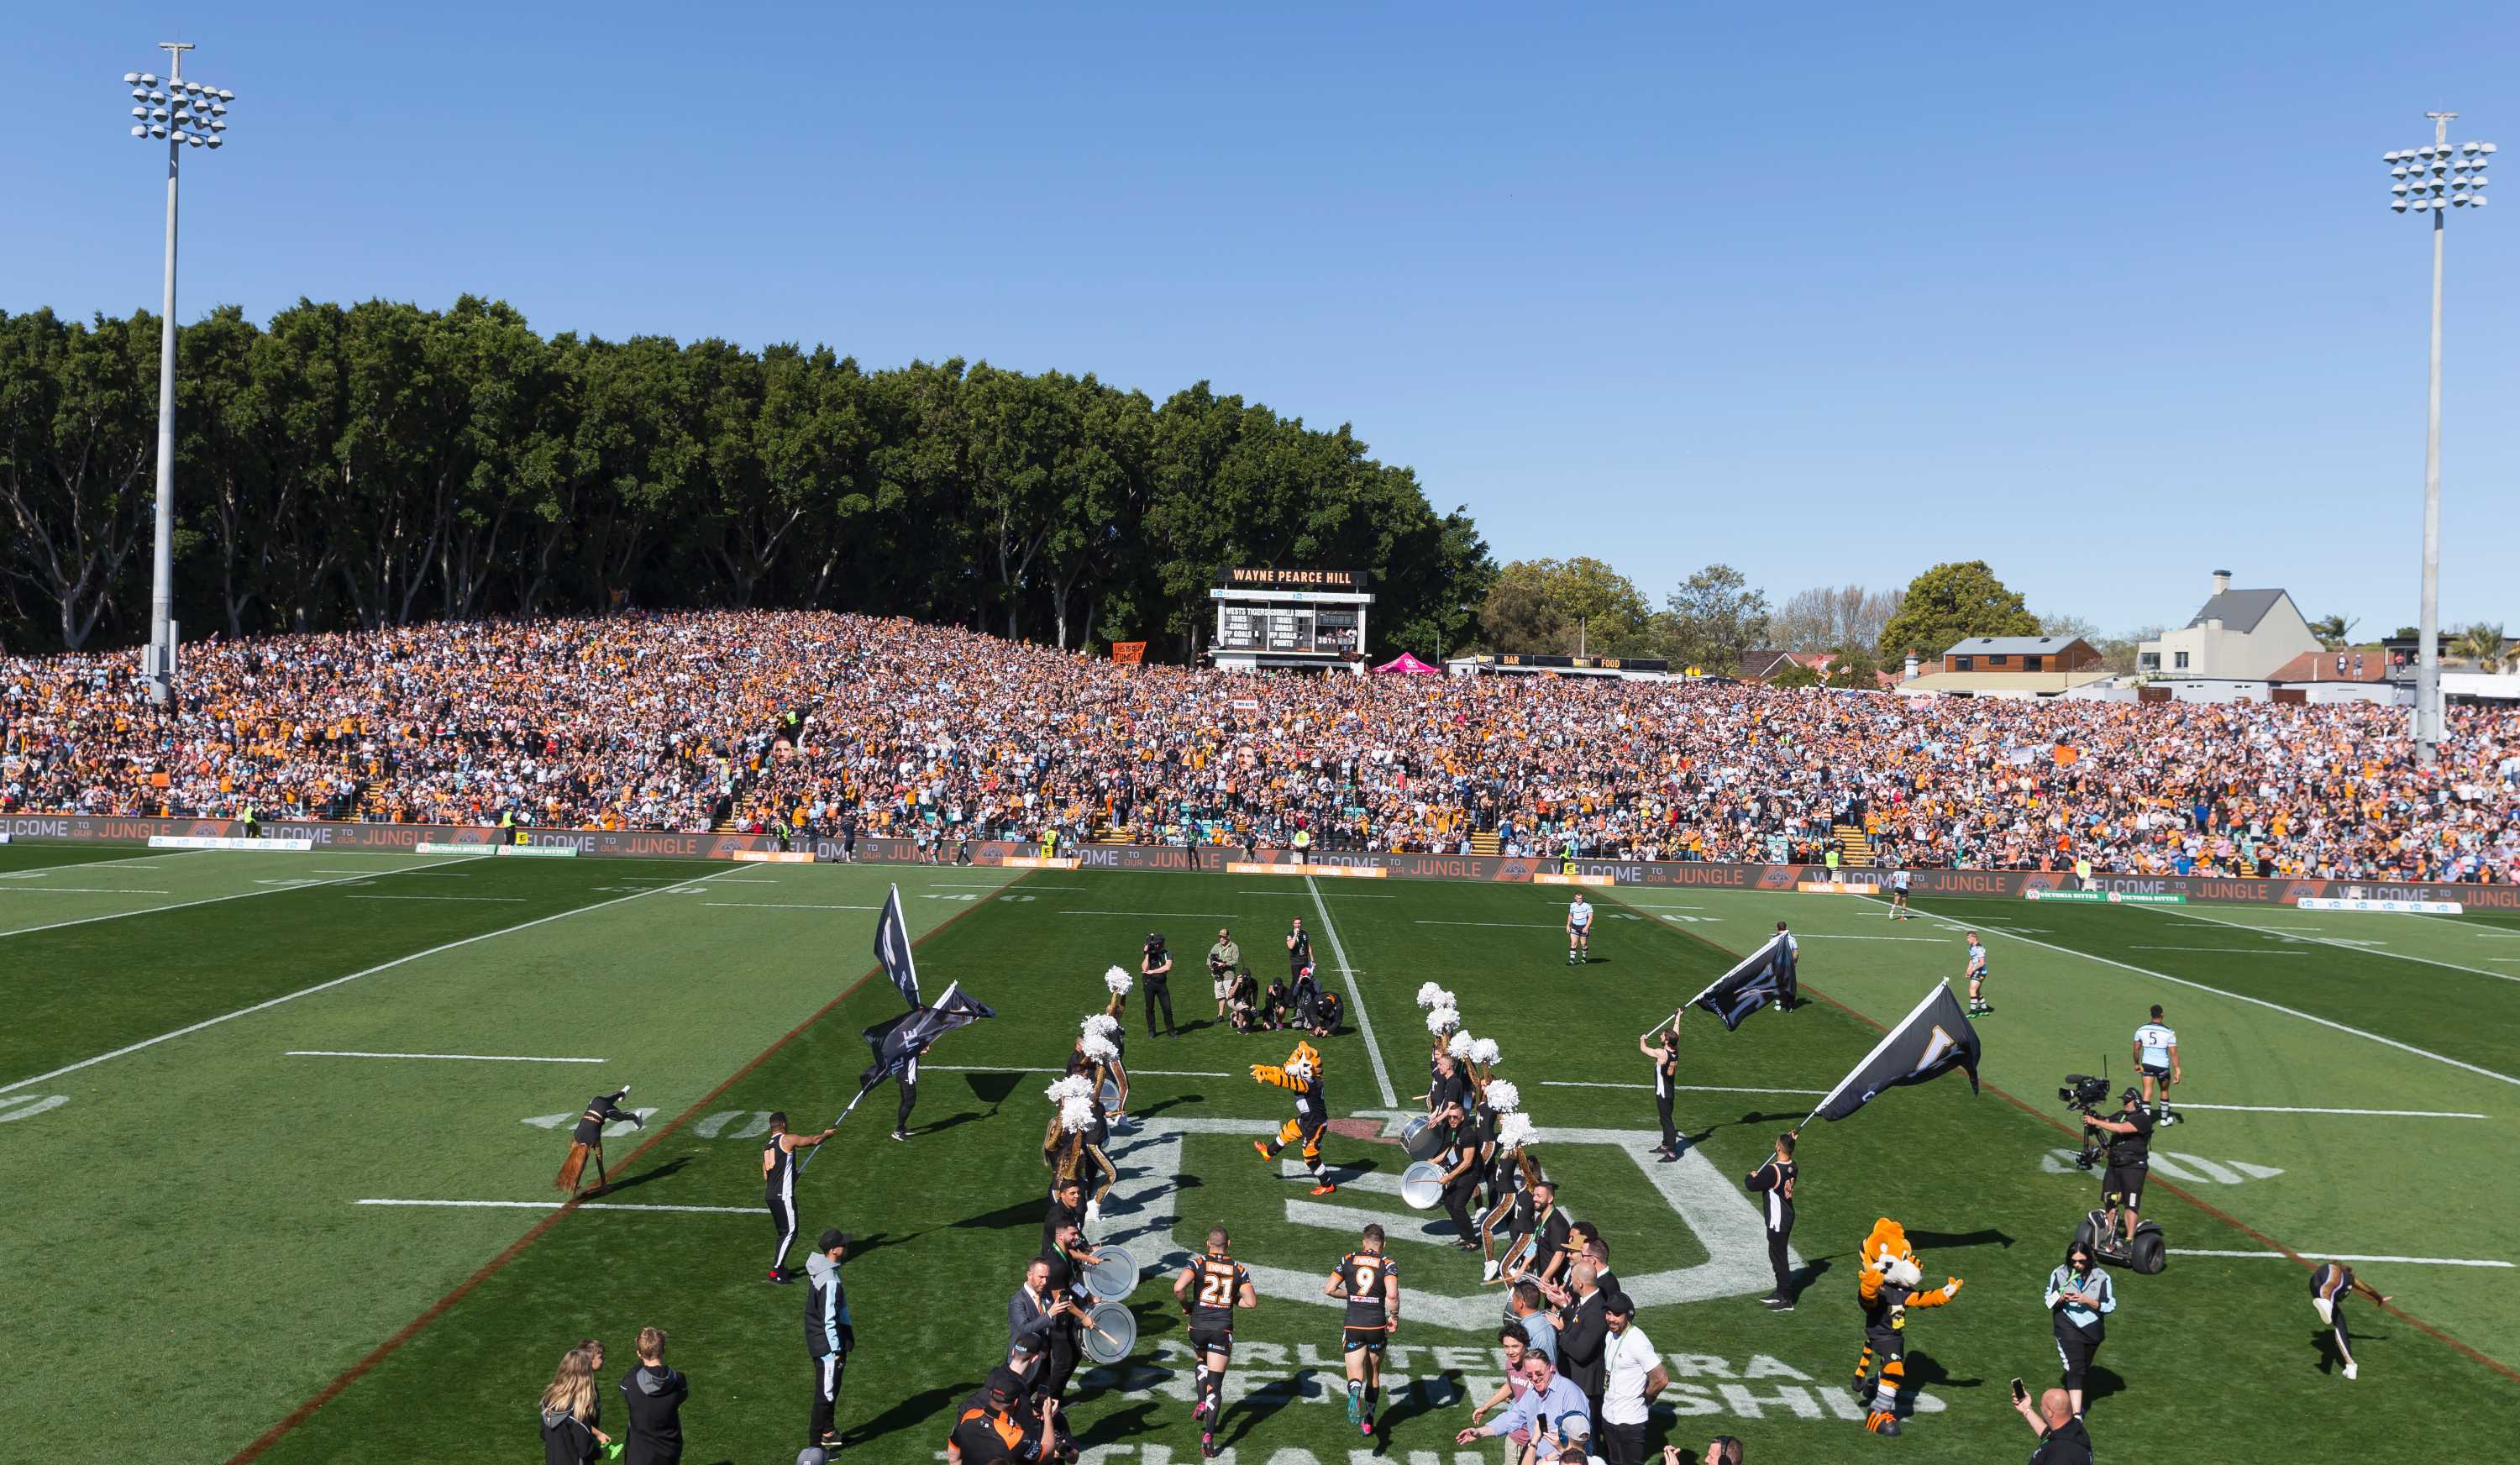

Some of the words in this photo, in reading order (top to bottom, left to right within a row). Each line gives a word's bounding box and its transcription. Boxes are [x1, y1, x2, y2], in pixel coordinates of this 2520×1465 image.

[1234, 570, 1273, 581] WAYNE
[1278, 571, 1321, 582] PEARCE
[1327, 573, 1351, 584] HILL
[1226, 607, 1246, 616] WESTS
[1247, 607, 1268, 617] TIGERS
[1504, 655, 1520, 665] BAR
[1601, 659, 1620, 669] FOOD
[73, 829, 93, 838] OUR
[99, 822, 171, 839] JUNGLE
[241, 827, 332, 844] ELCOME
[363, 830, 434, 846] JUNGLE
[505, 833, 596, 852] LCOME
[605, 837, 616, 845] TO
[626, 838, 696, 854] JUNGLE
[766, 841, 857, 859] WELOM
[863, 852, 881, 860] OUR
[888, 844, 958, 861] JUNLE
[1027, 848, 1119, 866] WLOME
[1124, 859, 1143, 867] OUR
[1150, 852, 1221, 869] JUNLE
[1290, 855, 1380, 869] ELCOME
[1410, 859, 1482, 876] JUNGLE
[1551, 864, 1641, 882] LCOME
[1647, 874, 1666, 883] OUR
[1672, 869, 1744, 885] JUNGLE
[1813, 871, 1893, 889] WLCOM
[1935, 875, 2006, 892] JUNGLE
[2074, 878, 2166, 895] LCOME
[2197, 883, 2268, 900] JUNGLE
[2150, 1032, 2157, 1045] 5
[1210, 1263, 1232, 1274] neds
[1357, 1257, 1378, 1266] neds
[1200, 1273, 1234, 1305] 21
[1355, 1266, 1375, 1297] 9
[1380, 1344, 1815, 1382] TERA
[1510, 1375, 1527, 1388] Hurley
